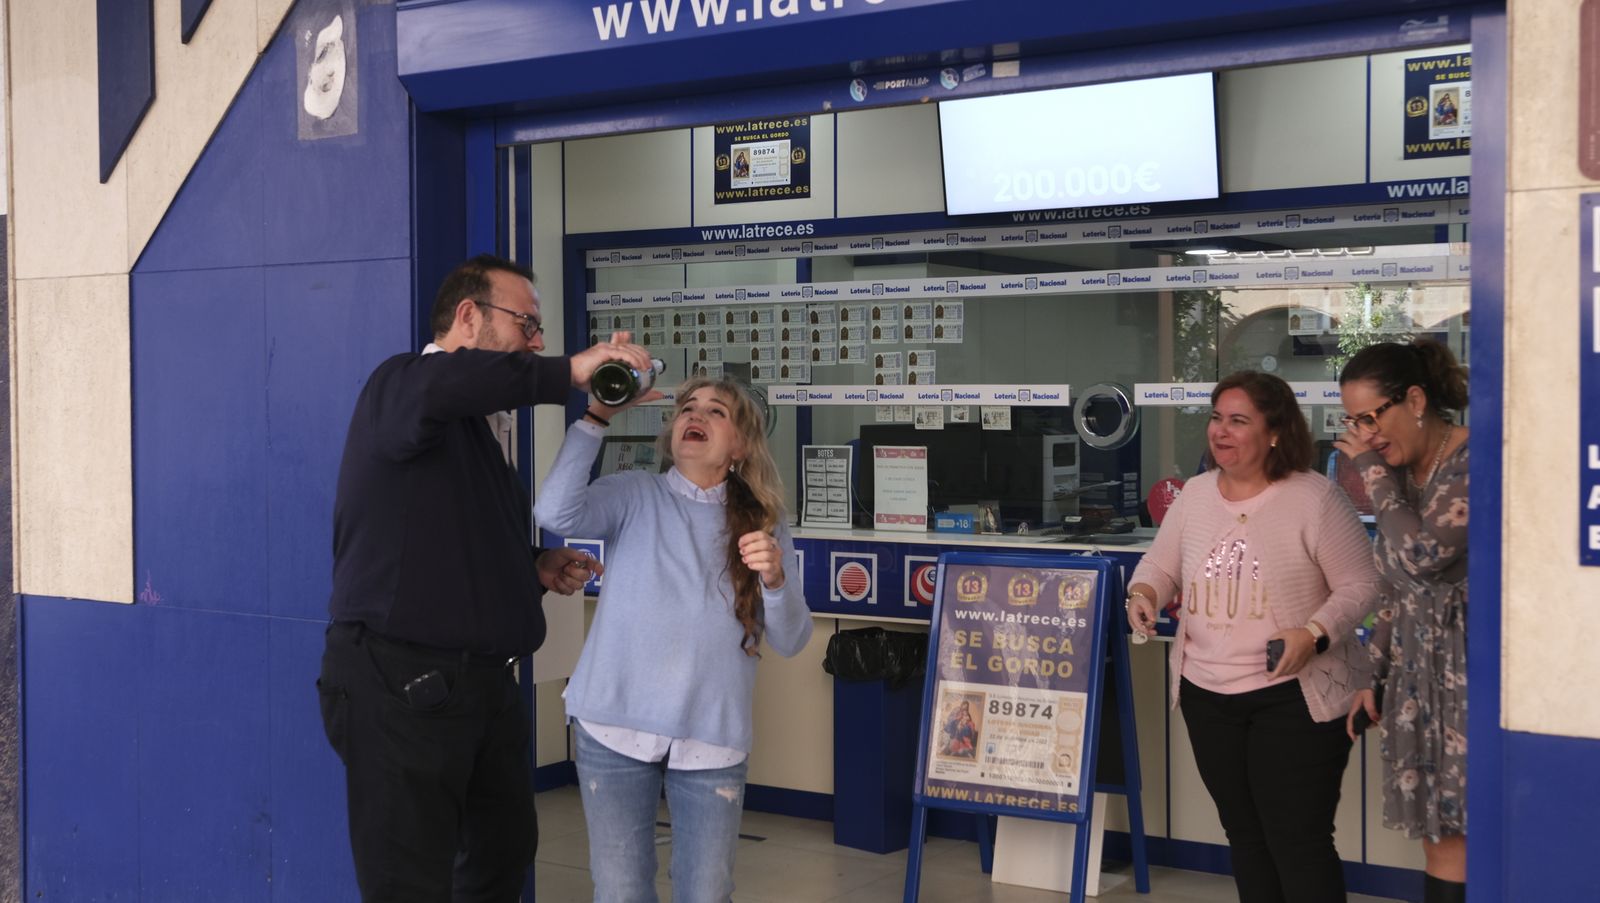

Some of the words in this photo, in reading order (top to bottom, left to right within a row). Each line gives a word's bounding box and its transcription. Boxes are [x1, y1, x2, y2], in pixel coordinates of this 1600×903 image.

[716, 118, 807, 134] www.latrece.es
[993, 162, 1161, 202] 200.000€
[716, 185, 809, 199] www.latrece.es
[1303, 216, 1335, 224] Nacional
[1402, 210, 1435, 218] Nacional
[701, 223, 814, 241] www.latrece.es
[1123, 227, 1152, 235] Nacional
[1210, 222, 1240, 230] Nacional
[1040, 232, 1067, 240] Nacional
[885, 239, 909, 247] Nacional
[1302, 269, 1333, 277] Nacional
[1400, 265, 1433, 273] Nacional
[1209, 272, 1239, 280] Nacional
[817, 449, 833, 458] BOTES
[964, 580, 979, 592] 13
[1016, 583, 1031, 595] 13
[1066, 586, 1081, 599] 13
[955, 609, 1087, 627] www.latrece.es
[955, 630, 983, 647] SE
[992, 632, 1074, 655] BUSCA
[951, 652, 978, 670] EL
[987, 655, 1073, 678] GORDO
[988, 700, 1053, 720] 89874
[927, 786, 1079, 813] WWW.LATRECE.ES
